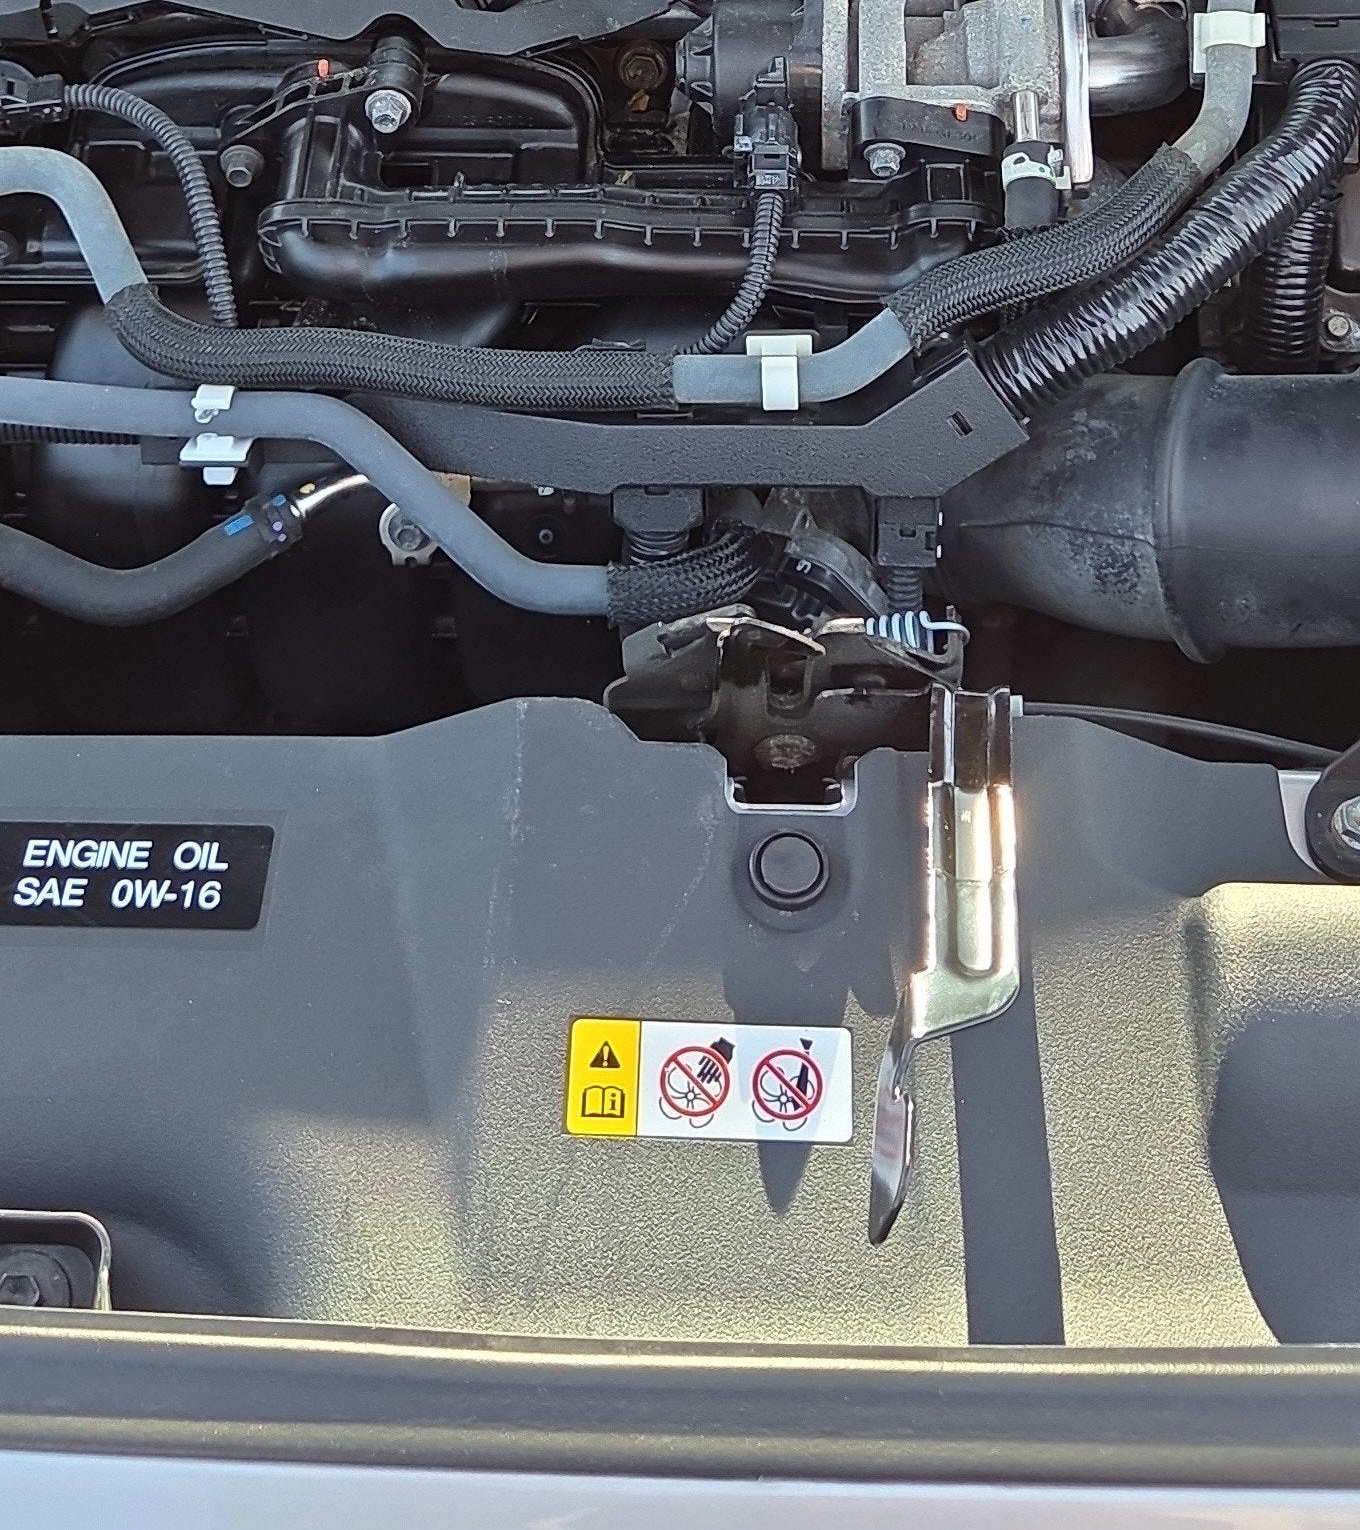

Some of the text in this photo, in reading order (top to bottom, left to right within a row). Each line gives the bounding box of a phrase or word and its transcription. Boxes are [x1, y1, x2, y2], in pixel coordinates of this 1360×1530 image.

[23, 840, 229, 871] ENGINE OIL
[13, 877, 222, 910] SAE 0W-16
